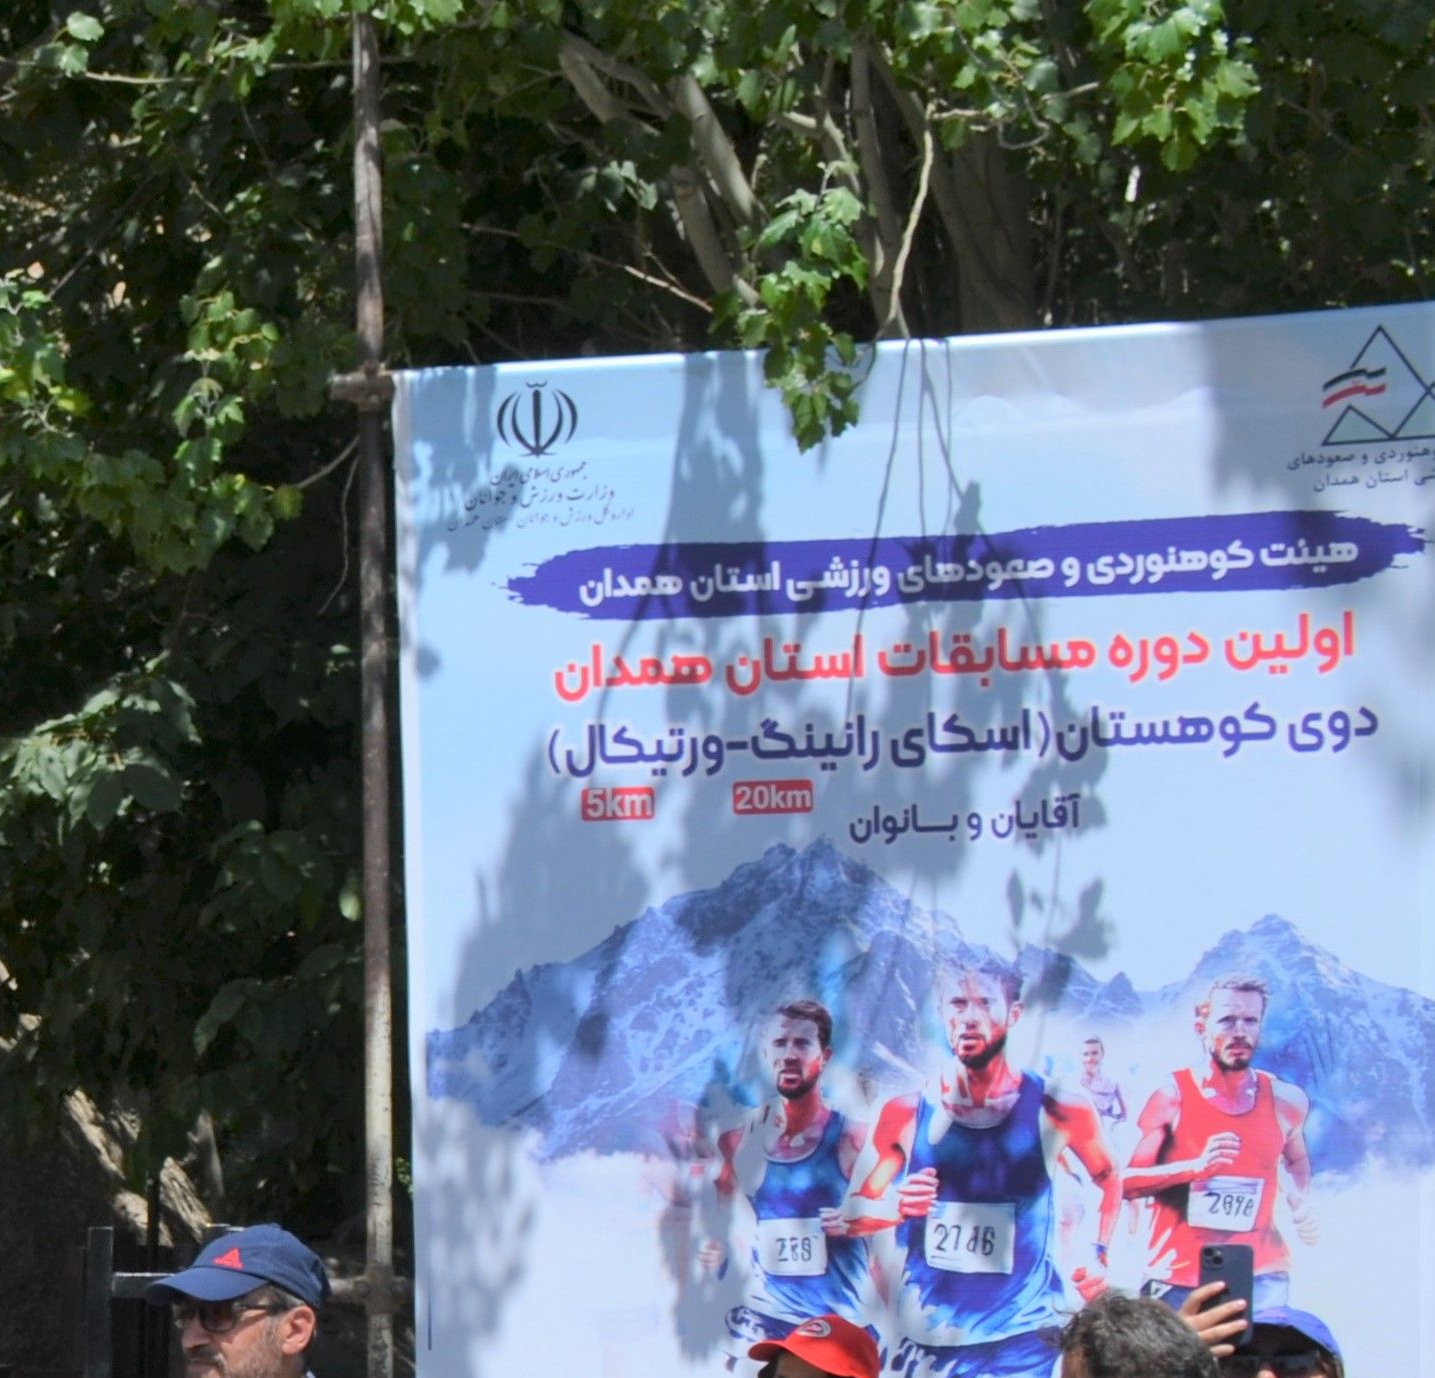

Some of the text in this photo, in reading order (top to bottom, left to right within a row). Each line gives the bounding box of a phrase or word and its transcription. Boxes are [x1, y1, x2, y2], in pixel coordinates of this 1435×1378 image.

[579, 536, 1360, 607] هیئت کوهنوردی و صعودهای ورزشی استان همدان
[553, 610, 1355, 703] اولین دوره مسابقات استان همدان
[1286, 704, 1379, 753] دوی
[585, 788, 654, 819] 5km
[733, 783, 812, 812] 20km
[990, 792, 1081, 840] آقایان
[966, 813, 983, 841] و
